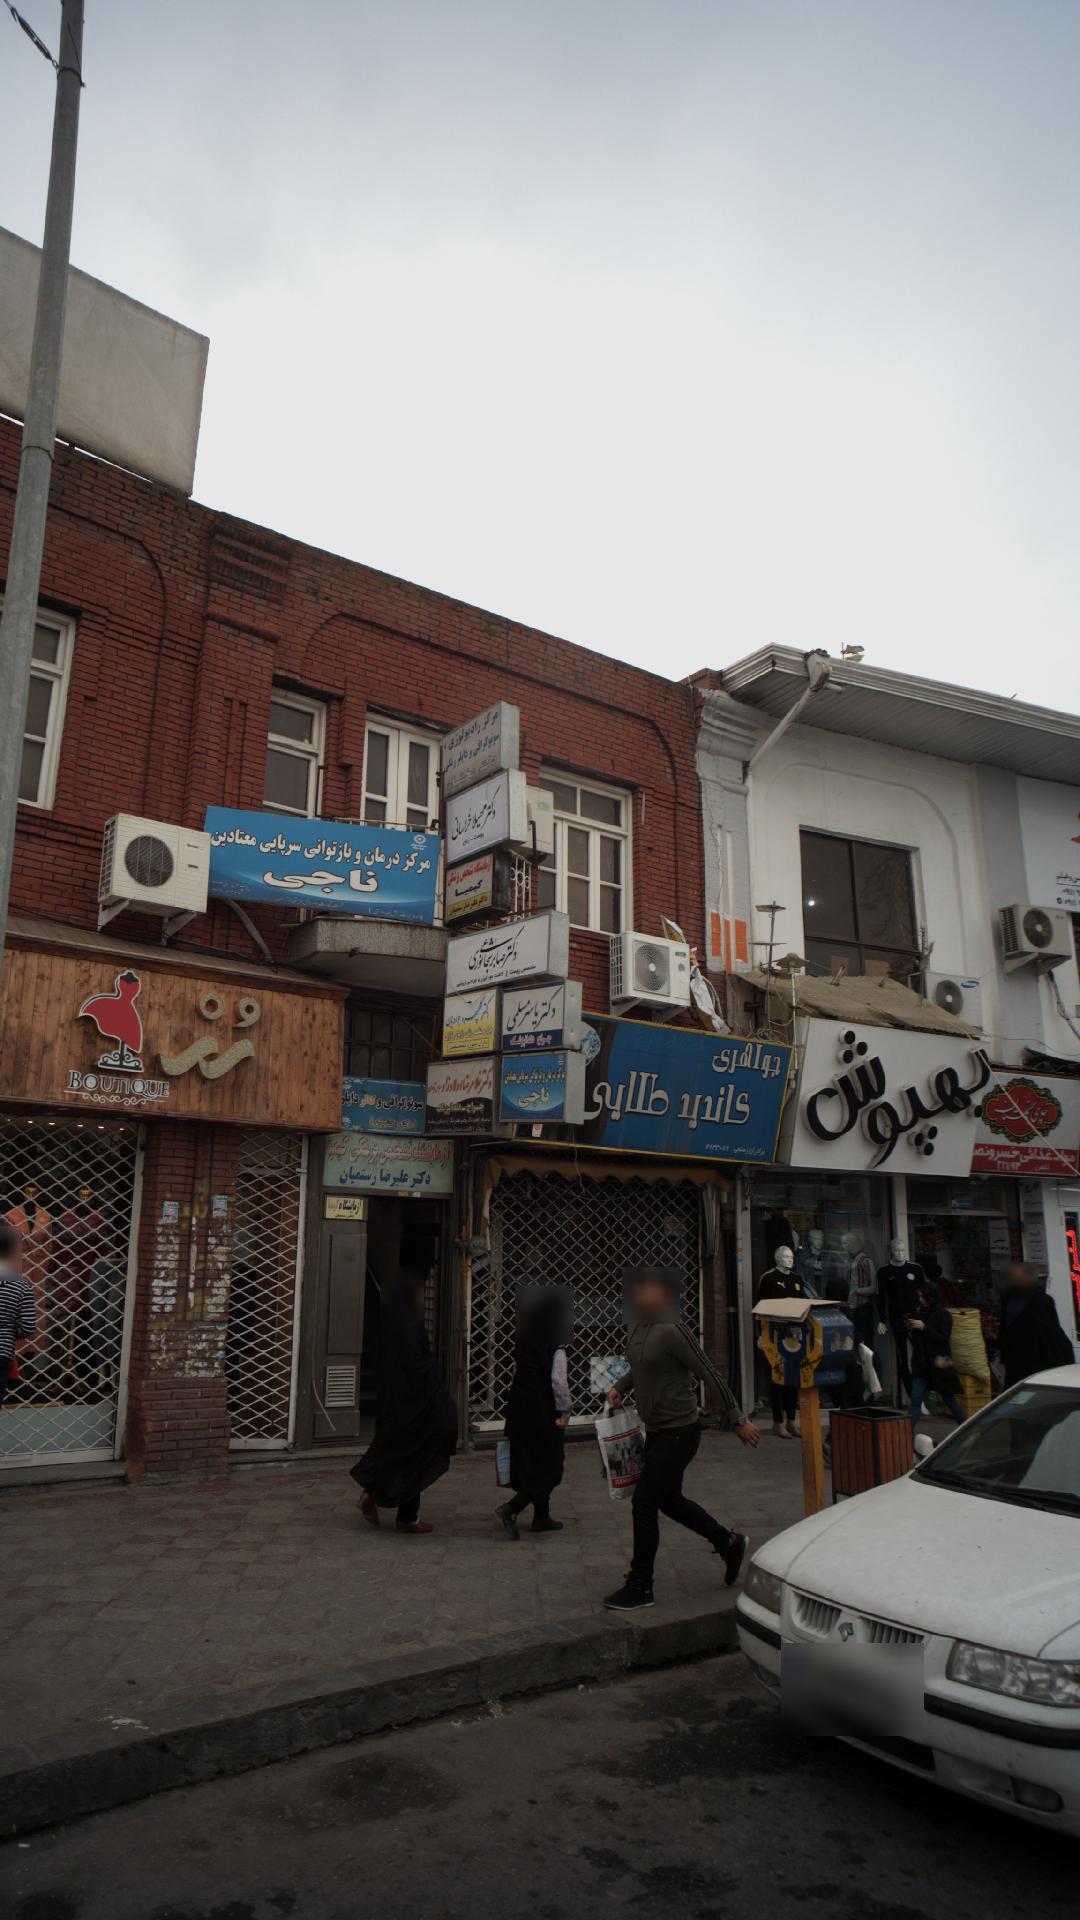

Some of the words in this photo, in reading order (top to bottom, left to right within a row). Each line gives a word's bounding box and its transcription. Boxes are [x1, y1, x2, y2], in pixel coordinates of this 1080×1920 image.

[210, 828, 257, 847] معتادین
[259, 833, 302, 857] سرپایی
[304, 839, 353, 863] بازتوانی
[353, 850, 362, 865] و
[363, 846, 400, 870] درمان
[402, 853, 432, 874] مرکز
[263, 869, 379, 894] ناجی
[533, 987, 562, 1030] دکتر
[711, 1042, 782, 1079] جواهری
[68, 1070, 170, 1099] BOUTIQUE
[583, 1070, 670, 1121] طلایی
[518, 1086, 551, 1108] ناجی
[677, 1083, 751, 1130] کاندید
[340, 1166, 376, 1185] رستمیان
[380, 1168, 408, 1187] علیرضا
[410, 1170, 431, 1188] دکتر
